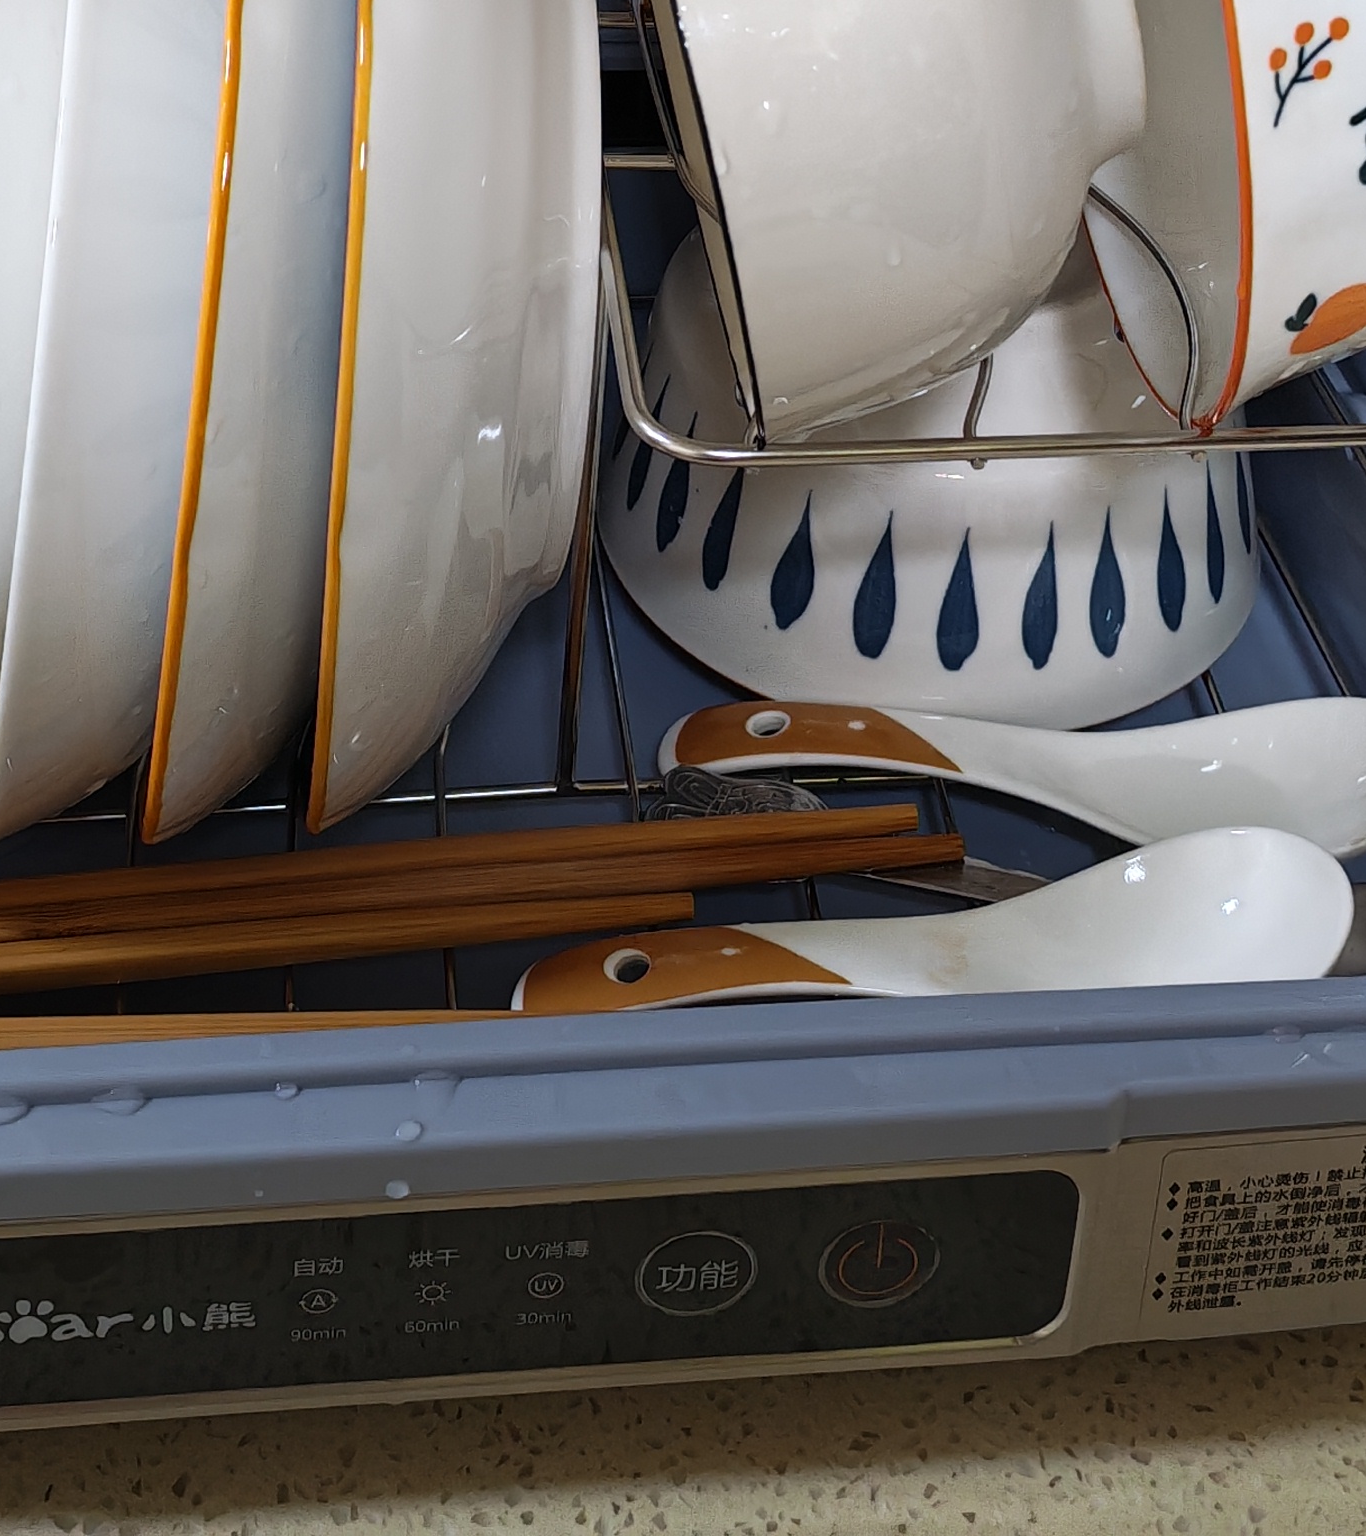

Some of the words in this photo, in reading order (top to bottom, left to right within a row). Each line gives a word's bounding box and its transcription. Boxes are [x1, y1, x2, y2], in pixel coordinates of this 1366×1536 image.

[408, 1247, 462, 1269] 烘干
[504, 1240, 591, 1263] UV消毒
[293, 1255, 345, 1278] 自动
[655, 1259, 740, 1292] 功能
[141, 1301, 257, 1334] 小熊
[404, 1318, 462, 1334] 60min
[515, 1310, 574, 1326] 30min
[290, 1326, 347, 1343] 90min
